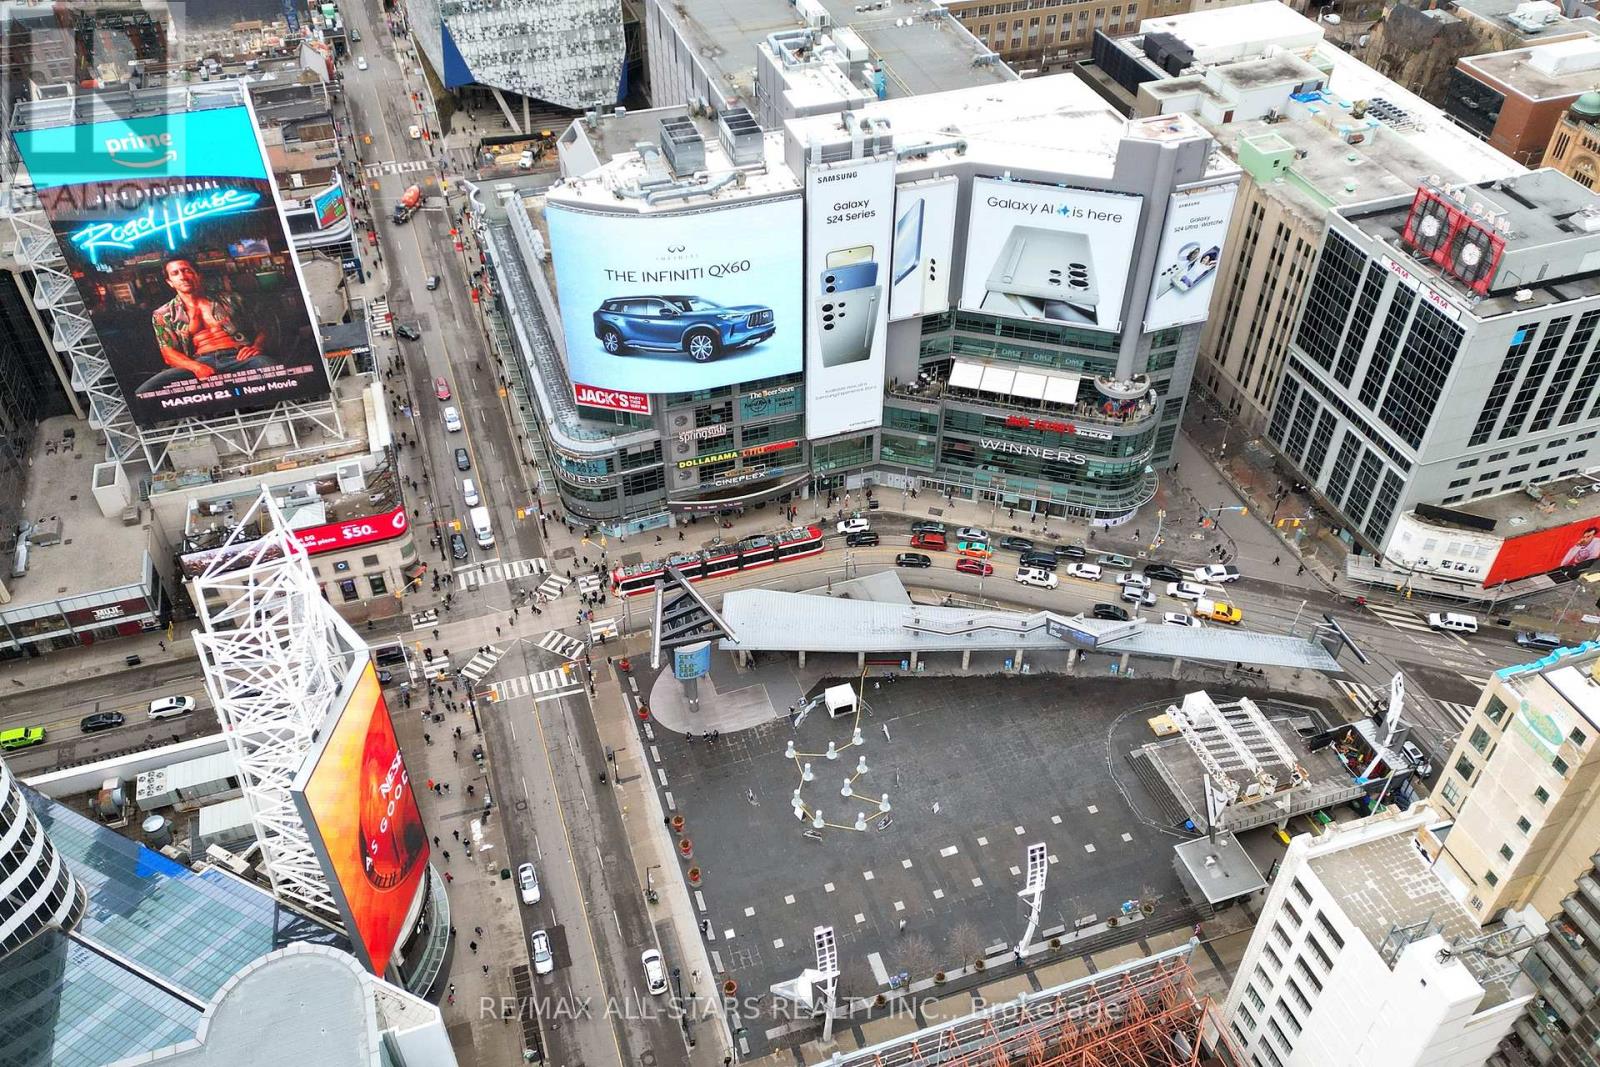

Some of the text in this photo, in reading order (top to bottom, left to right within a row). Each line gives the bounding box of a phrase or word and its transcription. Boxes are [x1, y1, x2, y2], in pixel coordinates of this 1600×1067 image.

[105, 131, 174, 154] prime
[817, 171, 858, 184] SAMSUNG
[833, 199, 870, 212] Galaxy
[987, 196, 1123, 223] Galaxy AI is here
[162, 188, 261, 250] House
[826, 209, 876, 225] S24 Series
[604, 259, 751, 283] THE INFINITI QX60
[161, 379, 298, 409] MARCH 21 New Movie
[577, 388, 630, 408] JACK'S
[679, 451, 739, 469] DOLLARAMA
[980, 438, 1087, 465] WINNERS
[716, 471, 766, 487] CINEPLEX
[342, 525, 372, 540] $50
